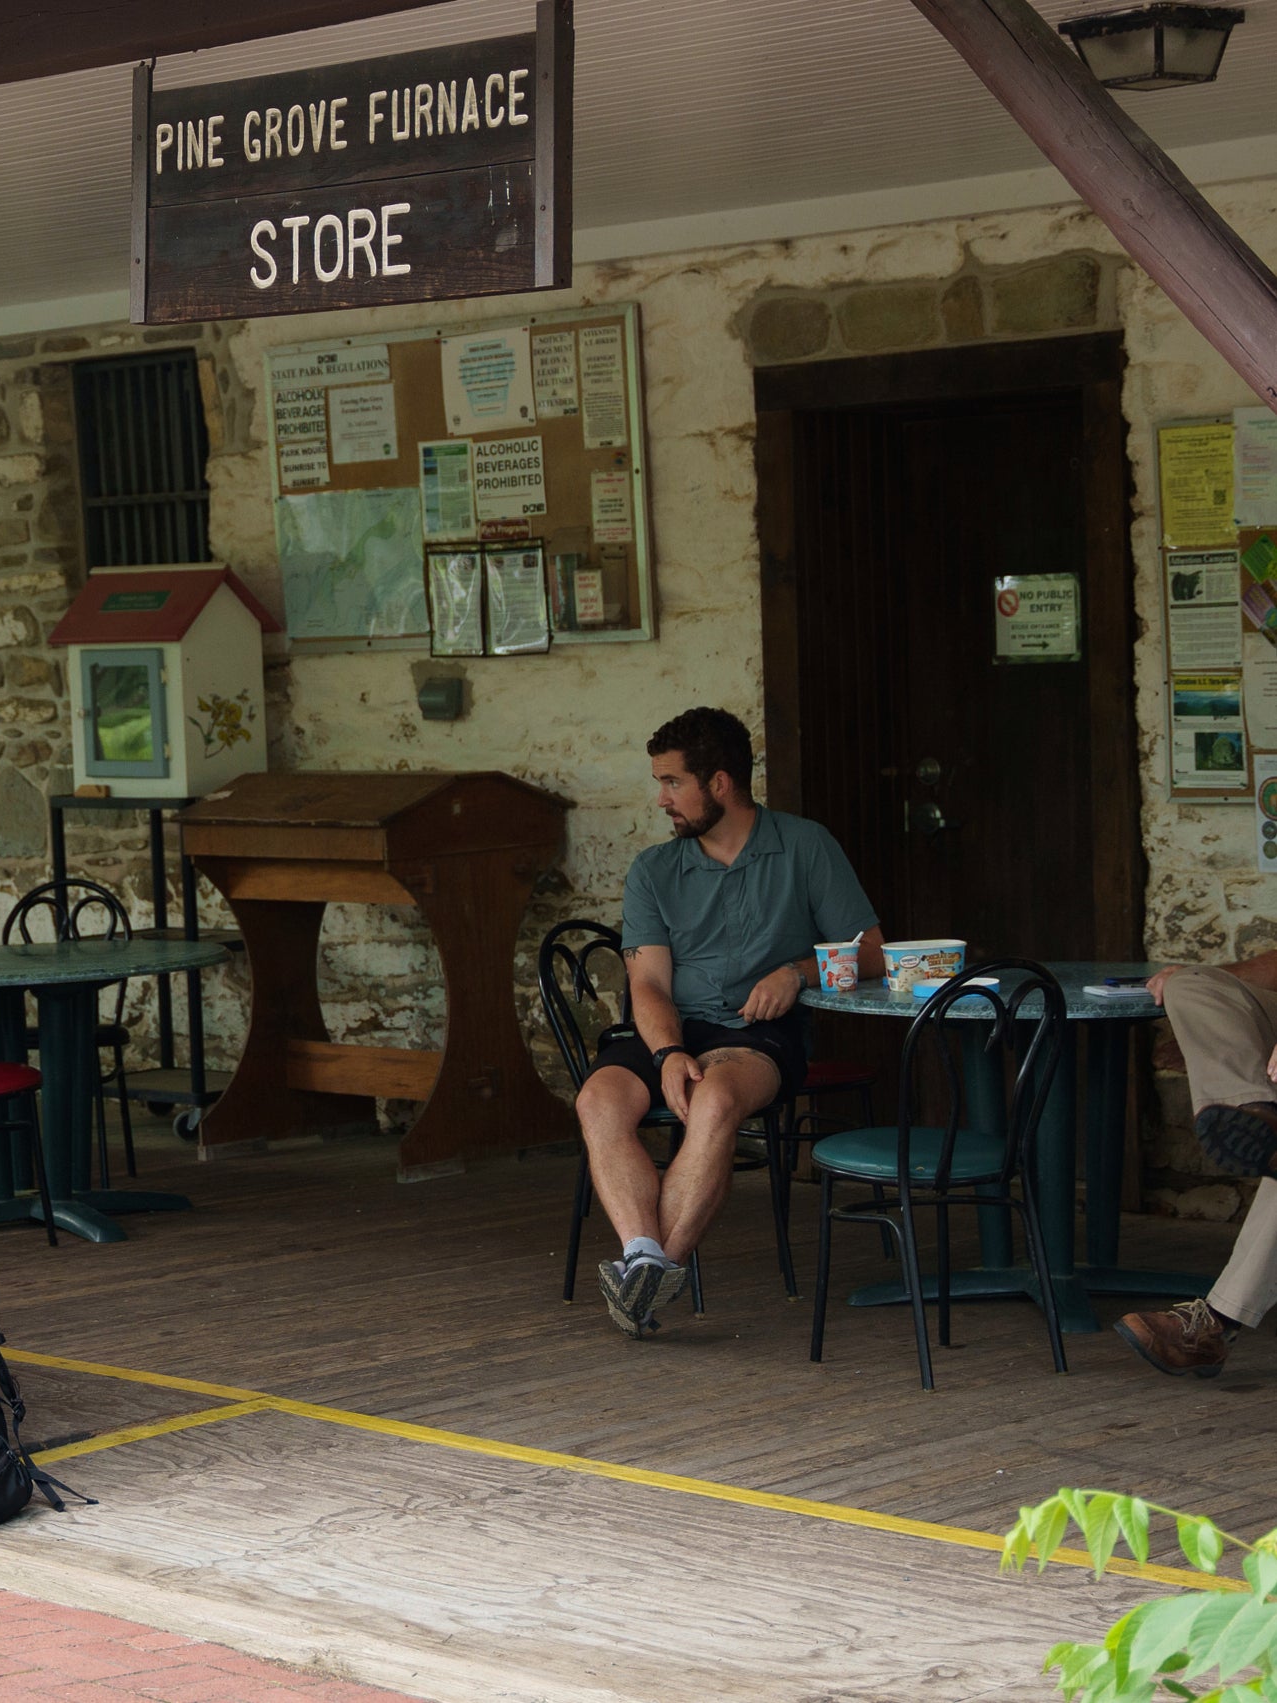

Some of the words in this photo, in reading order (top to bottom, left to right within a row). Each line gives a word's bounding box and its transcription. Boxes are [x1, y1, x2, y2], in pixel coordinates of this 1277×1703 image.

[156, 115, 224, 175] PINE
[243, 97, 348, 162] GROVE
[369, 69, 529, 144] FURNACE
[250, 202, 411, 289] STORE
[271, 367, 297, 380] STATE
[299, 367, 324, 378] PARK
[325, 358, 390, 374] REGULATIONS
[476, 440, 539, 457] ALCOHOLIC
[476, 457, 541, 474] BEVERAGES
[476, 473, 542, 490] PROHIBITED
[1019, 591, 1034, 600] NO
[1036, 590, 1073, 599] PUBLIC
[1030, 603, 1063, 613] ENTRY
